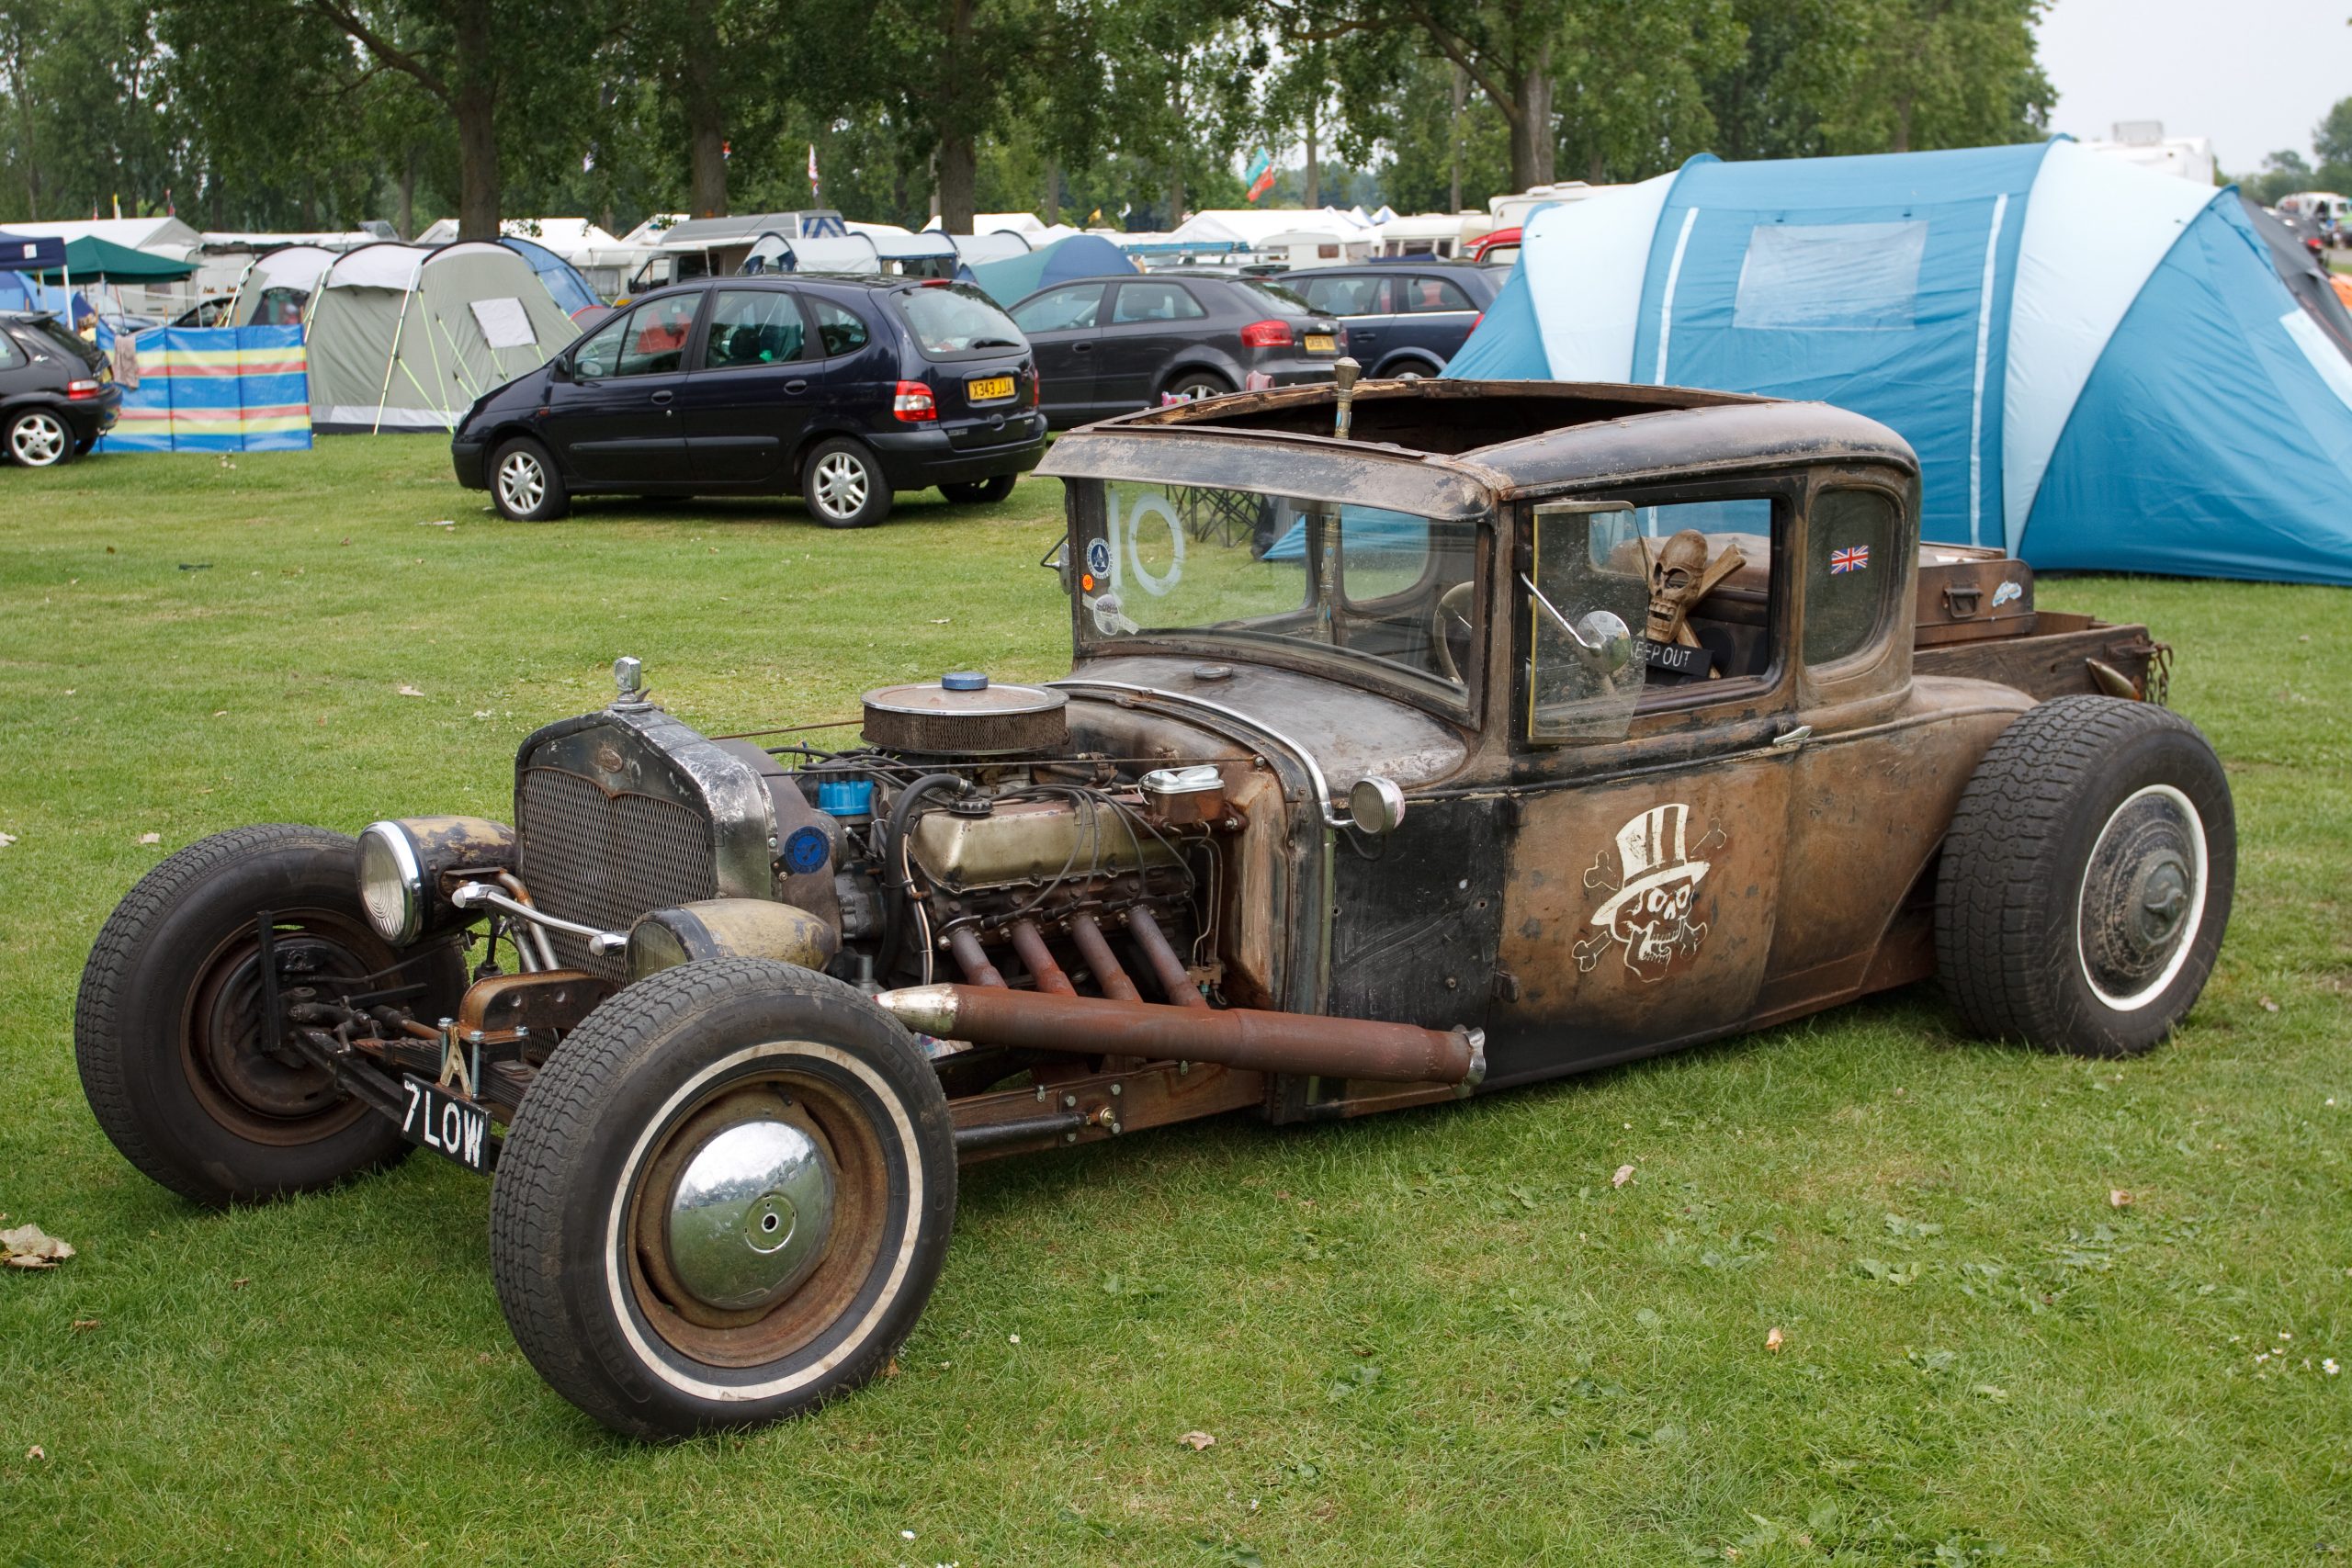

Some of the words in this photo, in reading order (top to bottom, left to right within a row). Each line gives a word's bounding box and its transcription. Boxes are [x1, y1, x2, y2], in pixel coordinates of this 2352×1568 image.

[973, 382, 995, 397] X343
[998, 379, 1012, 394] JJA
[1663, 647, 1691, 667] OUT
